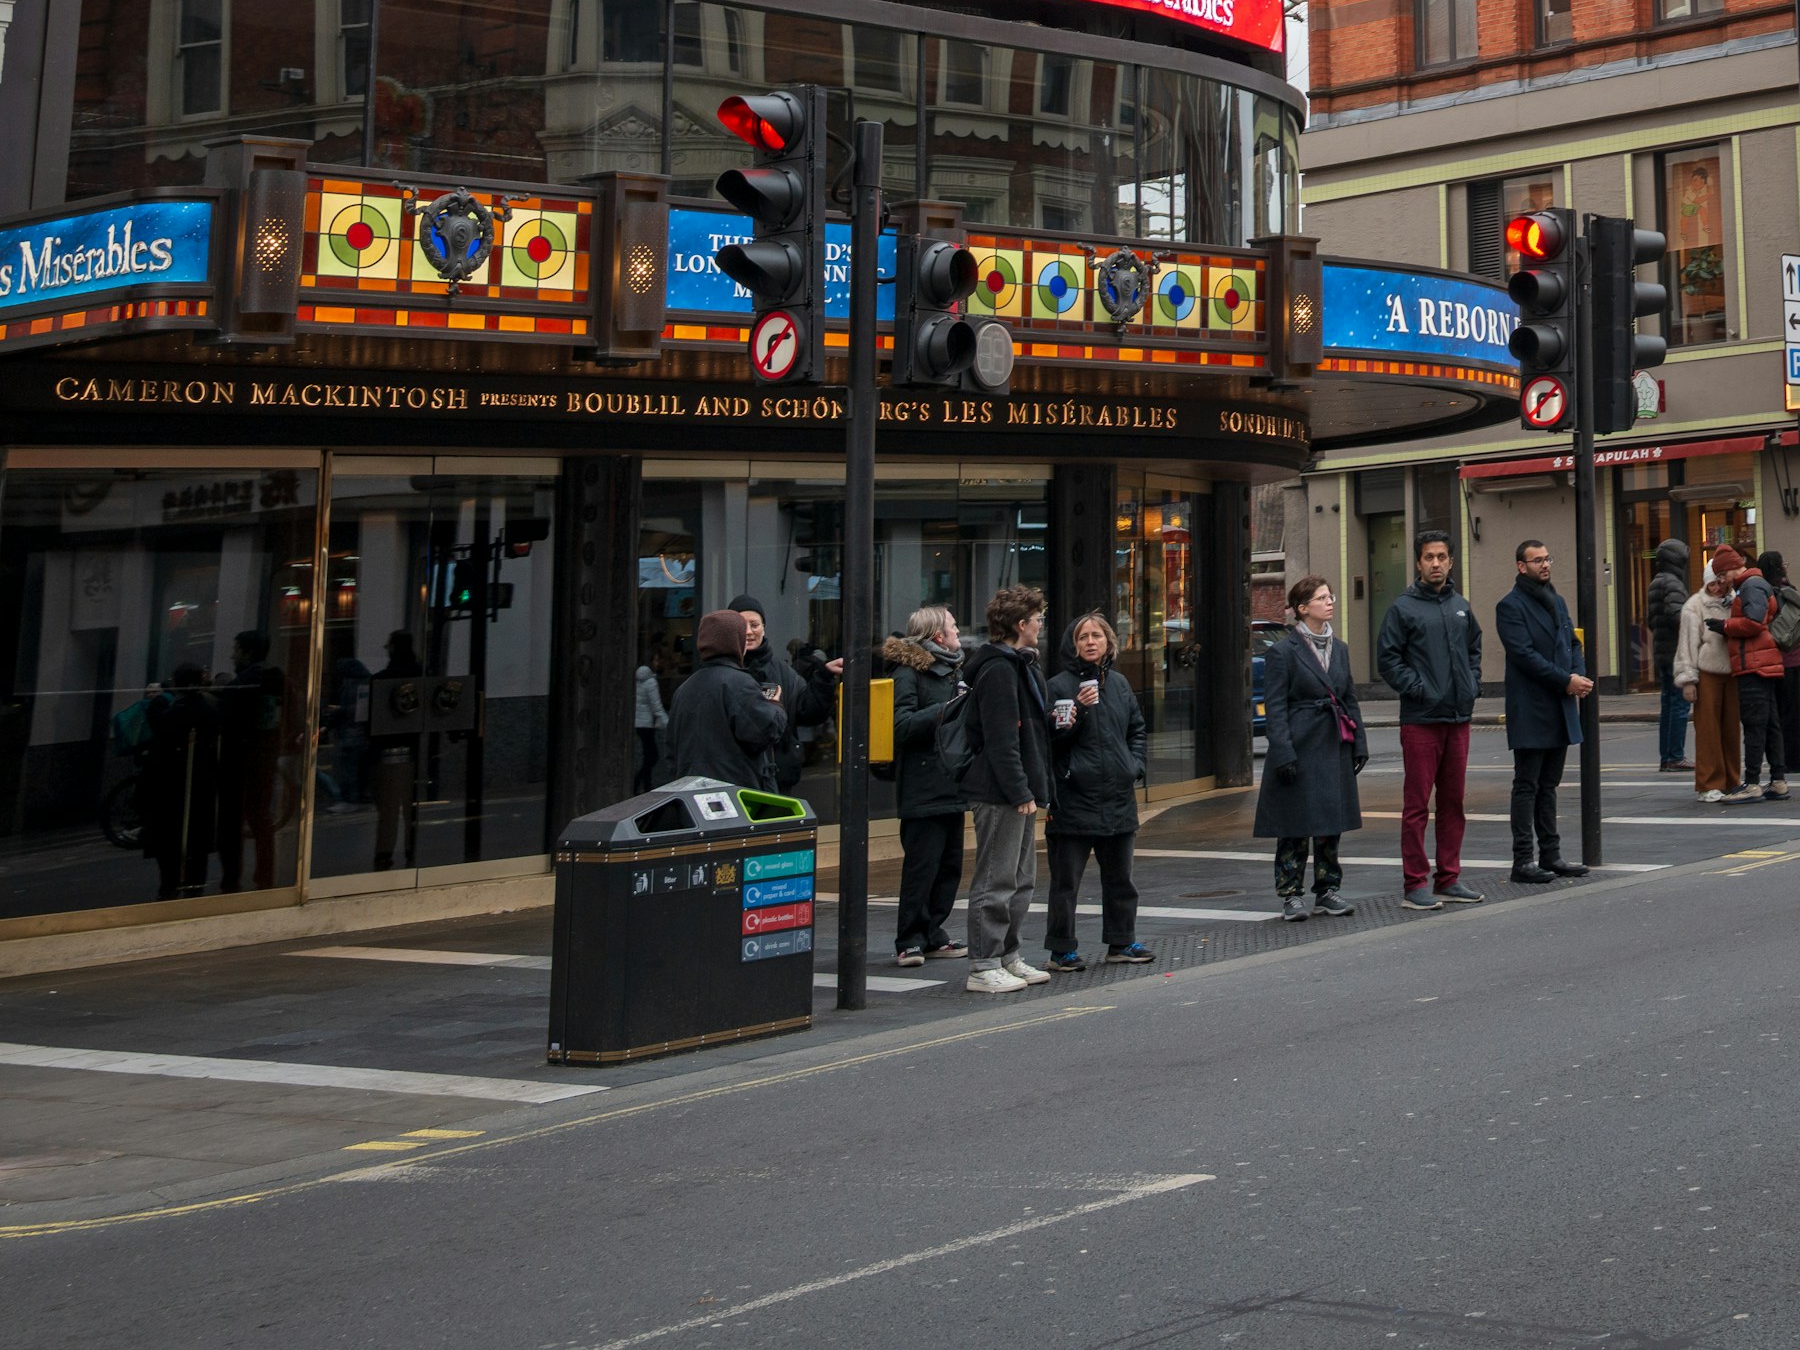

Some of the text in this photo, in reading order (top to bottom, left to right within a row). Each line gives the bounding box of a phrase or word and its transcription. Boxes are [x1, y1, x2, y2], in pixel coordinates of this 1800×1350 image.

[17, 219, 173, 295] Misérables
[1418, 297, 1511, 347] REBORN
[55, 376, 1179, 429] CAMERON MACKINTOSH PRESENTS BOUBLIL AND SCHÖNRG'S LES MISÉRABLES
[1565, 448, 1650, 467] SAPULAH
